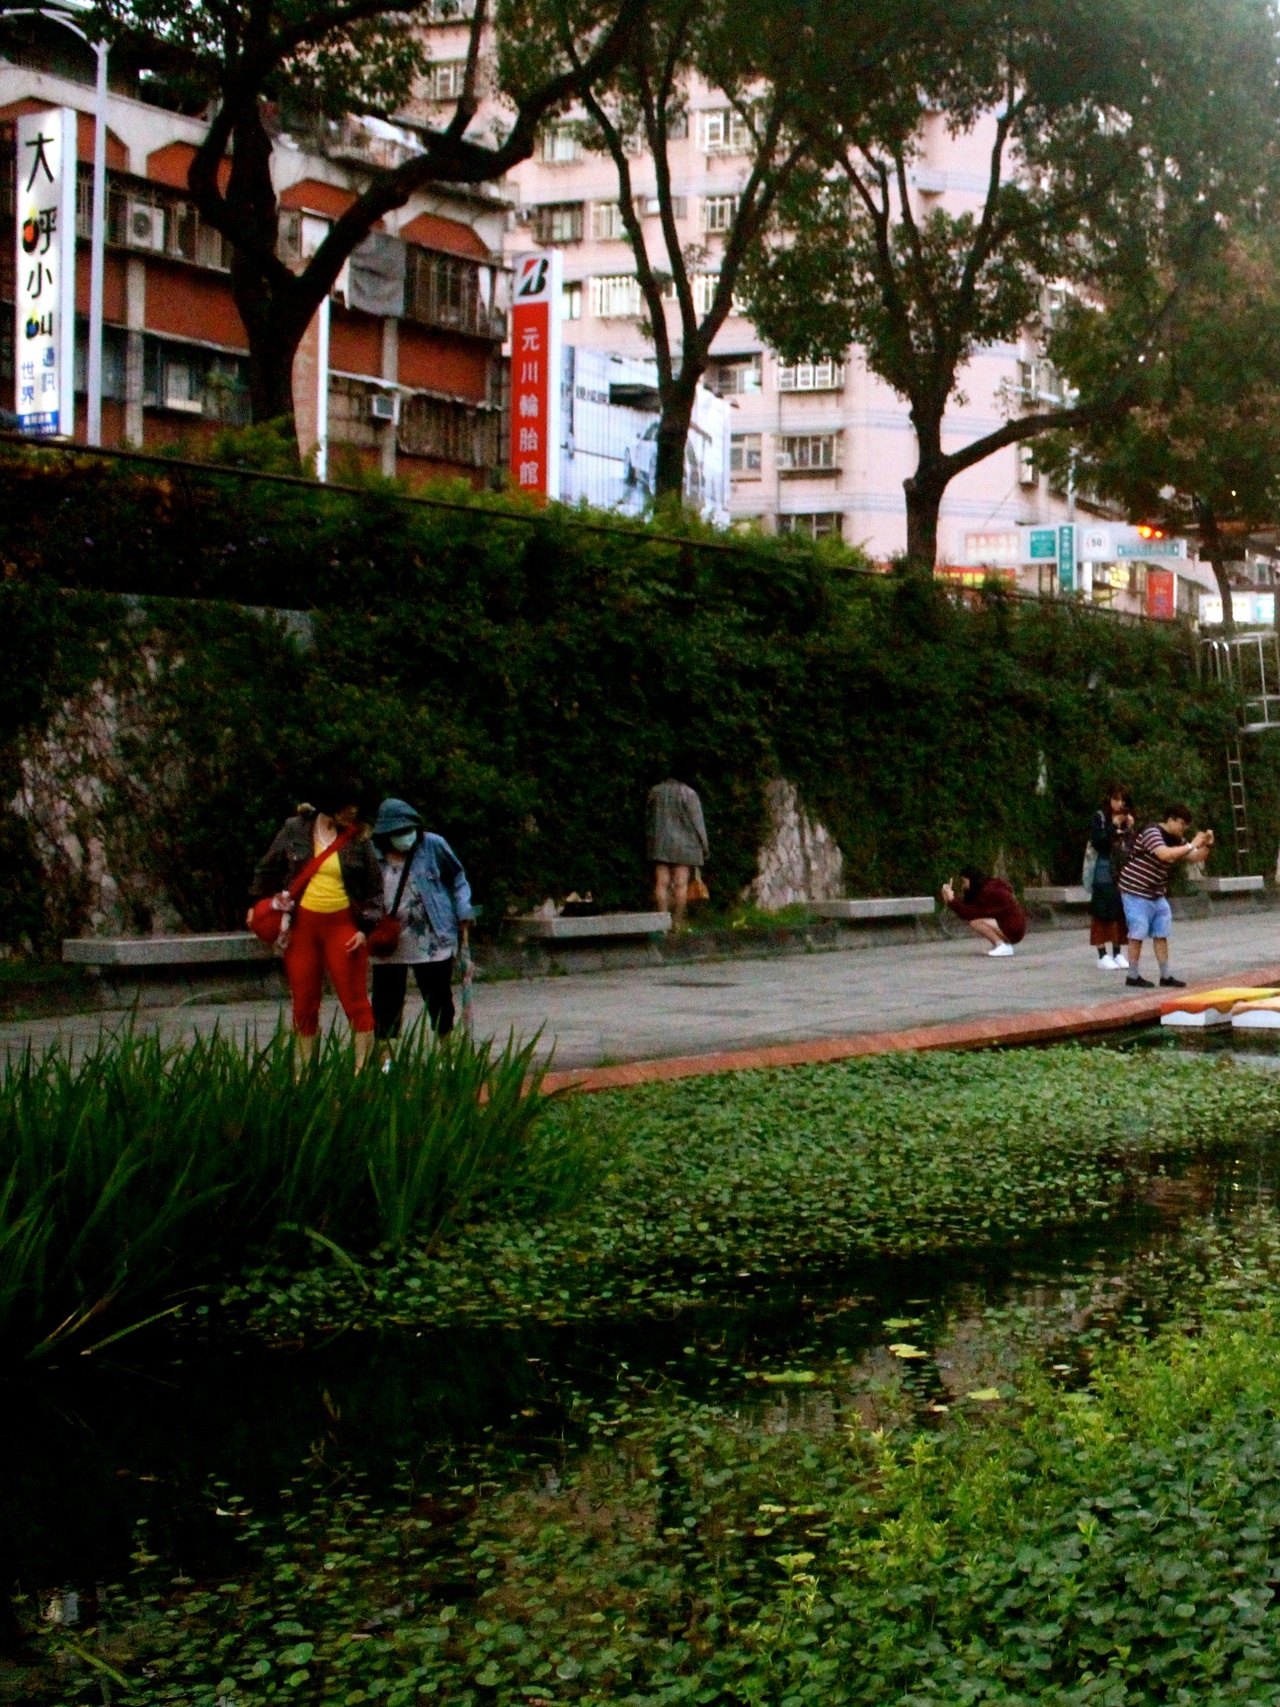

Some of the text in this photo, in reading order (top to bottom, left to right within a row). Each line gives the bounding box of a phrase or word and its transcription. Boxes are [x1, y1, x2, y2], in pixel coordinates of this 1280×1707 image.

[22, 131, 57, 340] 大呼小叫
[21, 361, 35, 405] 世界
[519, 326, 540, 485] 元川輪胎館
